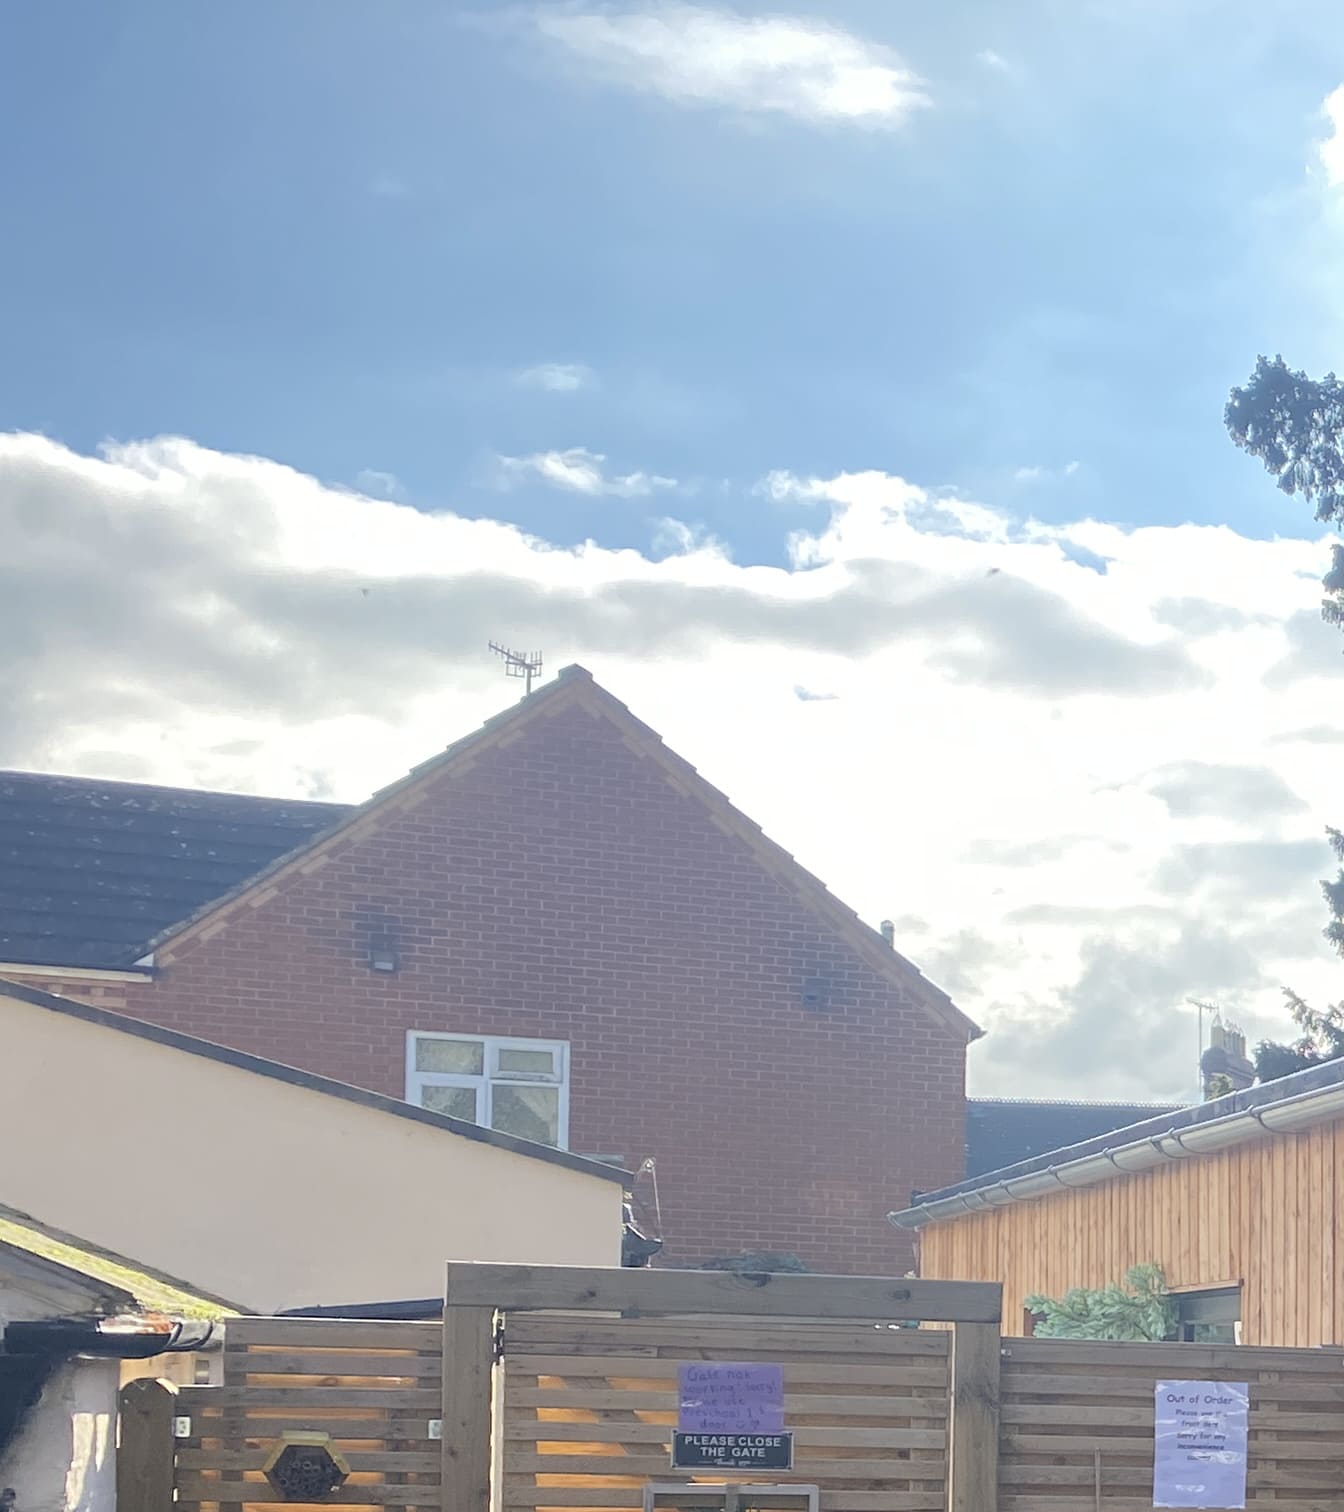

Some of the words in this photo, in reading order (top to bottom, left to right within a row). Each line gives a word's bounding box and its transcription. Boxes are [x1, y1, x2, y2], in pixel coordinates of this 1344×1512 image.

[1167, 1394, 1185, 1403] Out
[1188, 1394, 1199, 1404] of
[1203, 1395, 1233, 1405] Order
[684, 1435, 736, 1446] PLEASE
[738, 1436, 781, 1447] CLOSE
[700, 1447, 725, 1457] THE
[731, 1447, 766, 1458] GATE
